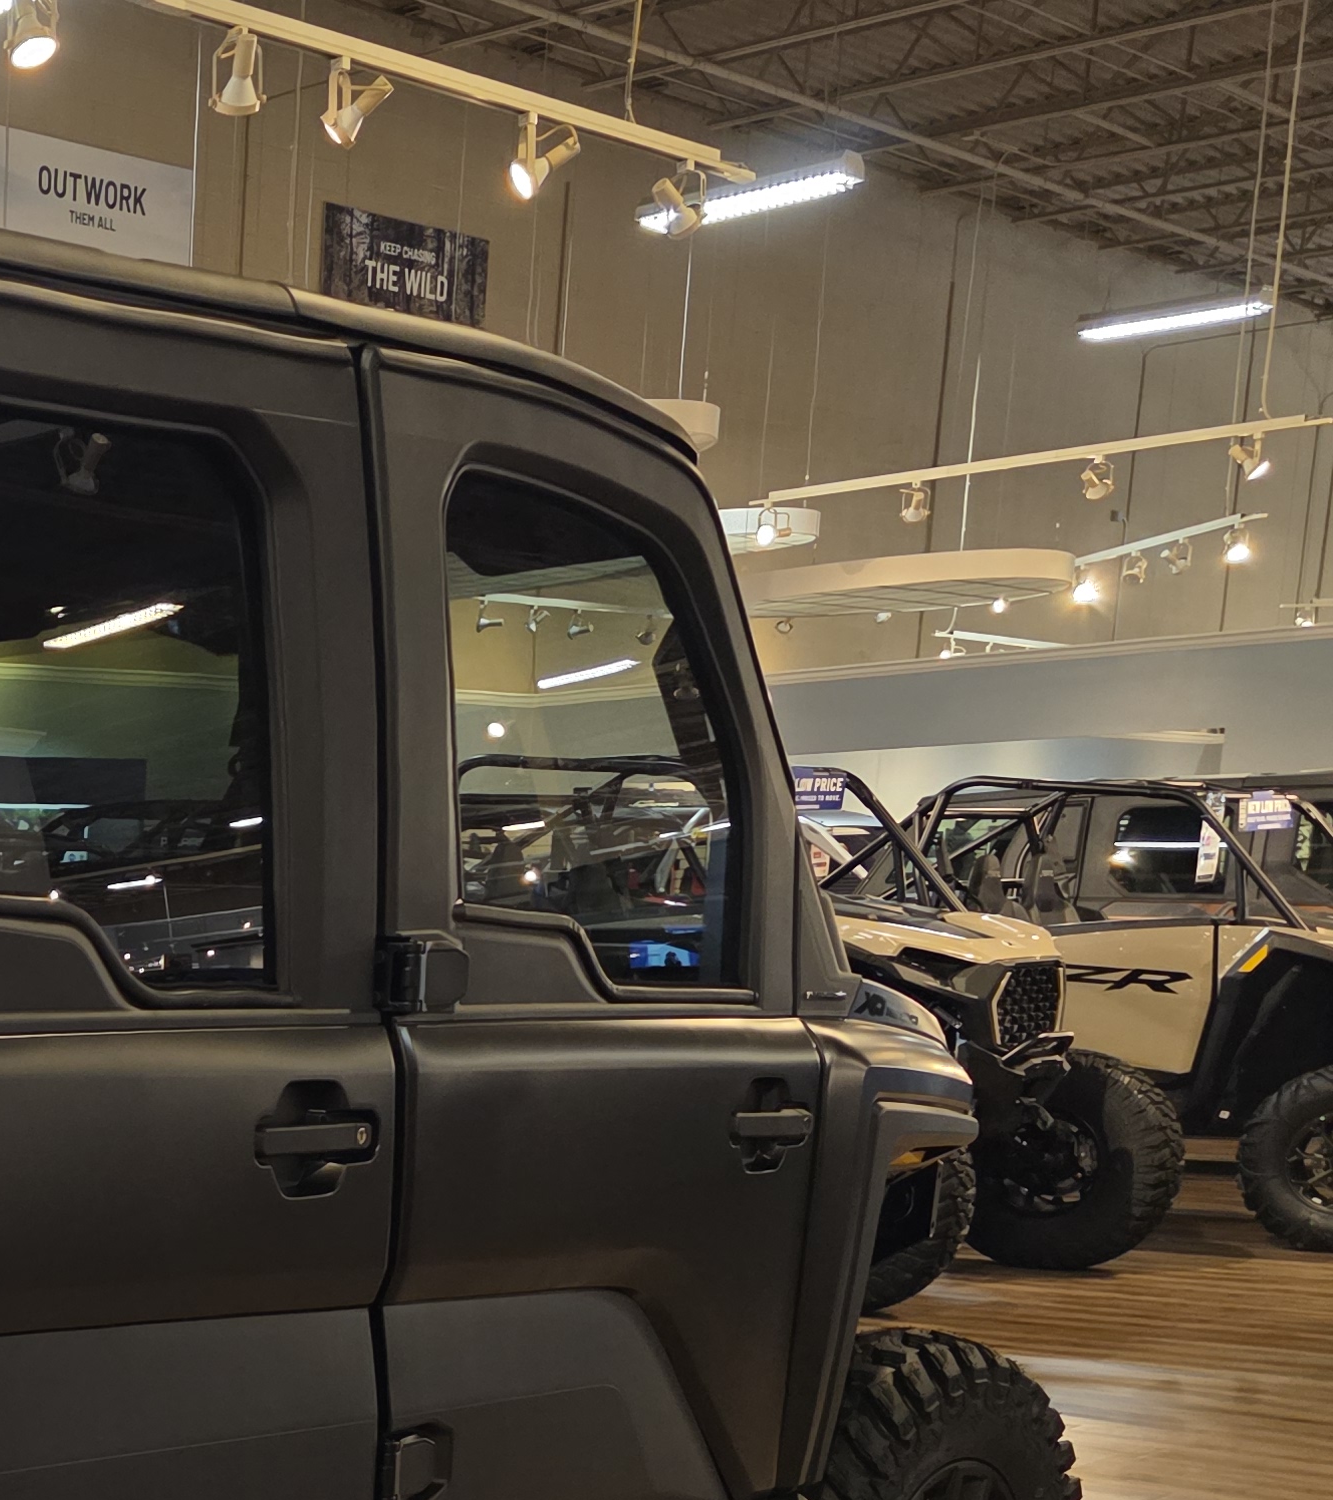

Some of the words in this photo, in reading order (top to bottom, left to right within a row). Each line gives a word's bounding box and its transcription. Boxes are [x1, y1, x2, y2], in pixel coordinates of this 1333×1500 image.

[38, 165, 147, 217] OUTWORK
[69, 210, 95, 229] THEM
[97, 216, 116, 232] ALL
[380, 241, 401, 257] KEEP
[402, 246, 437, 266] CHASING
[365, 259, 400, 293] THE
[404, 267, 449, 302] WILD
[814, 777, 844, 792] PRICE
